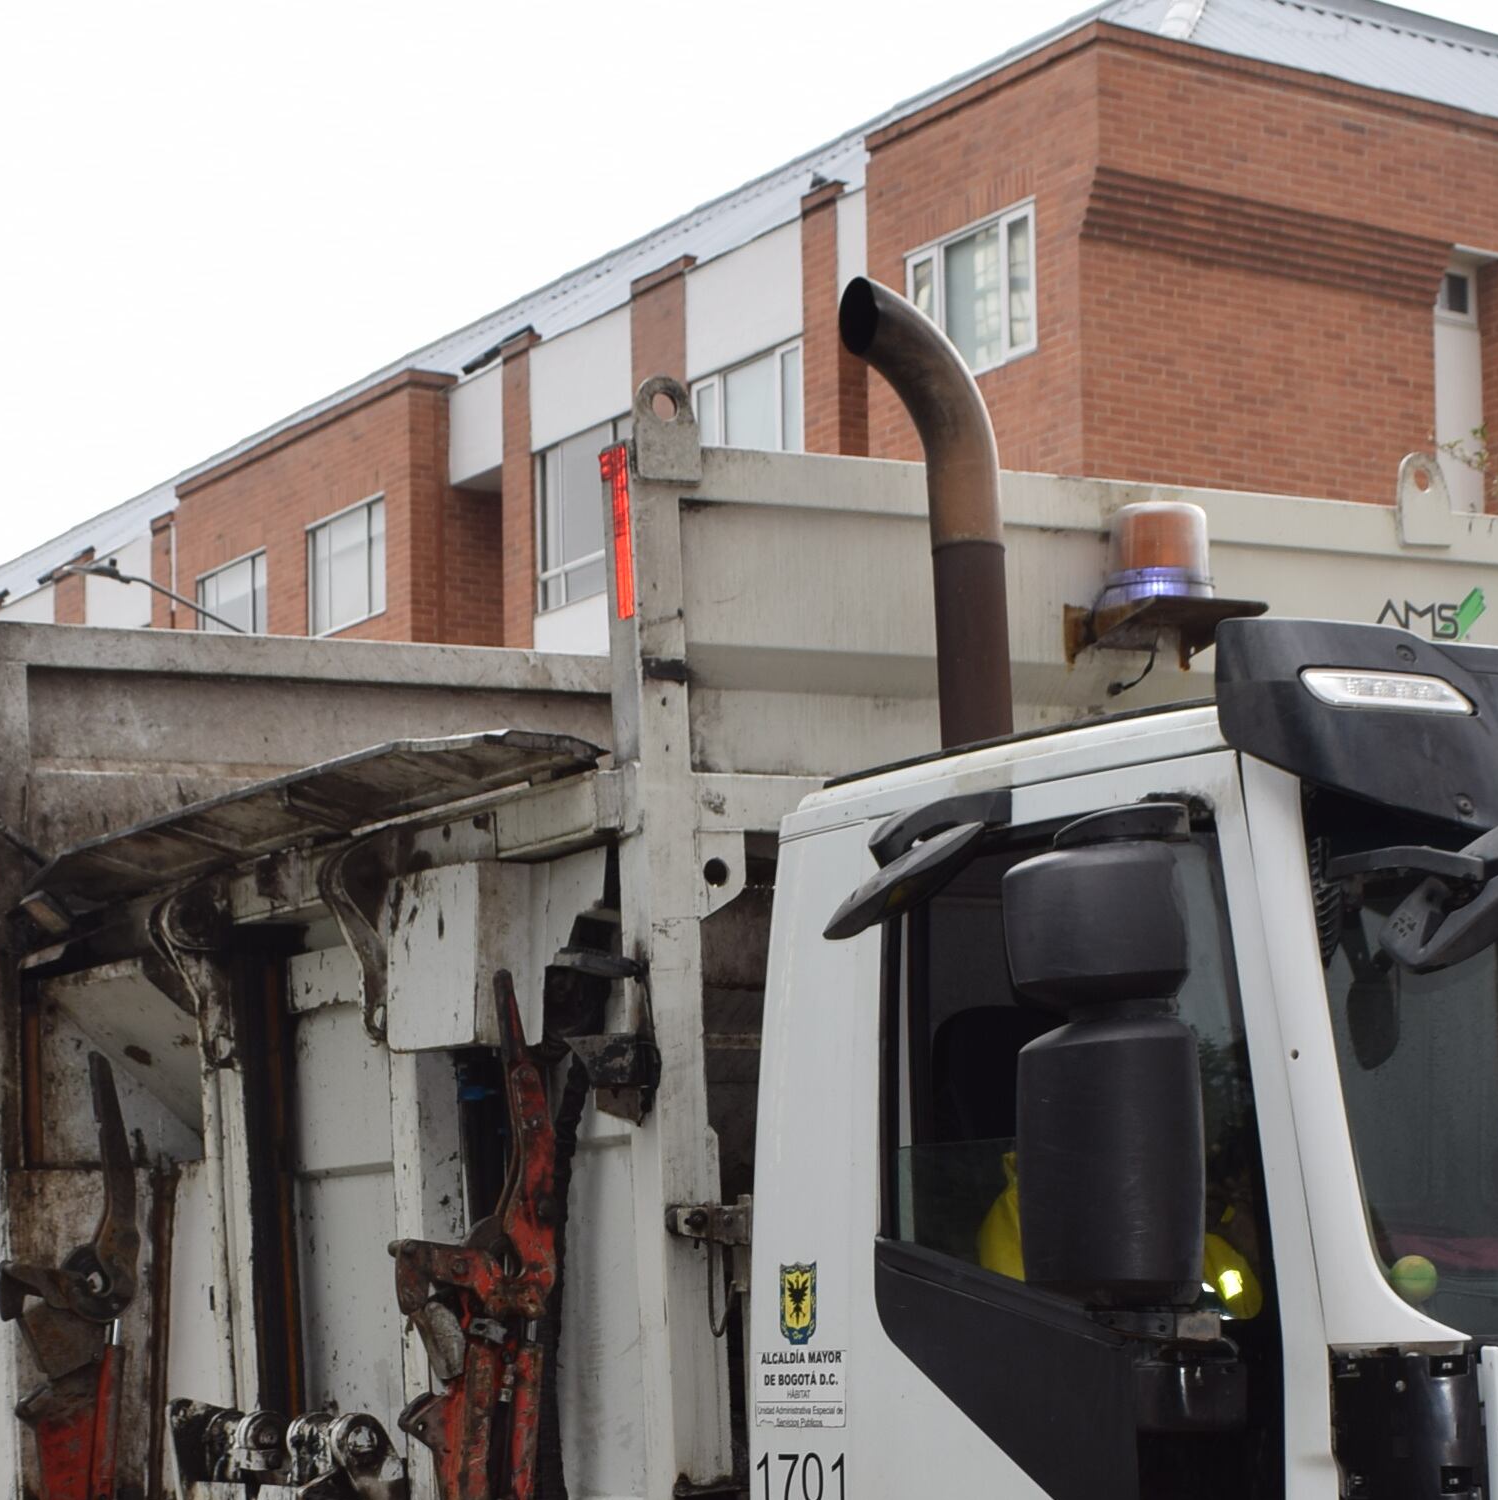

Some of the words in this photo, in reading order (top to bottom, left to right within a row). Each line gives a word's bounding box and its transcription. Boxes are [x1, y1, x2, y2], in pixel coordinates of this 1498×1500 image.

[1376, 599, 1458, 639] AMS
[761, 1350, 805, 1364] ALCALDÍA
[808, 1351, 842, 1363] MAYOR
[764, 1374, 776, 1386] DE
[778, 1371, 817, 1386] BOGOTÁ
[819, 1373, 839, 1386] D.C.
[786, 1388, 811, 1399] HÁBITAT
[757, 1406, 775, 1415] Unidad
[776, 1406, 811, 1415] Administrativa
[812, 1405, 835, 1417] Especial
[836, 1406, 843, 1415] de
